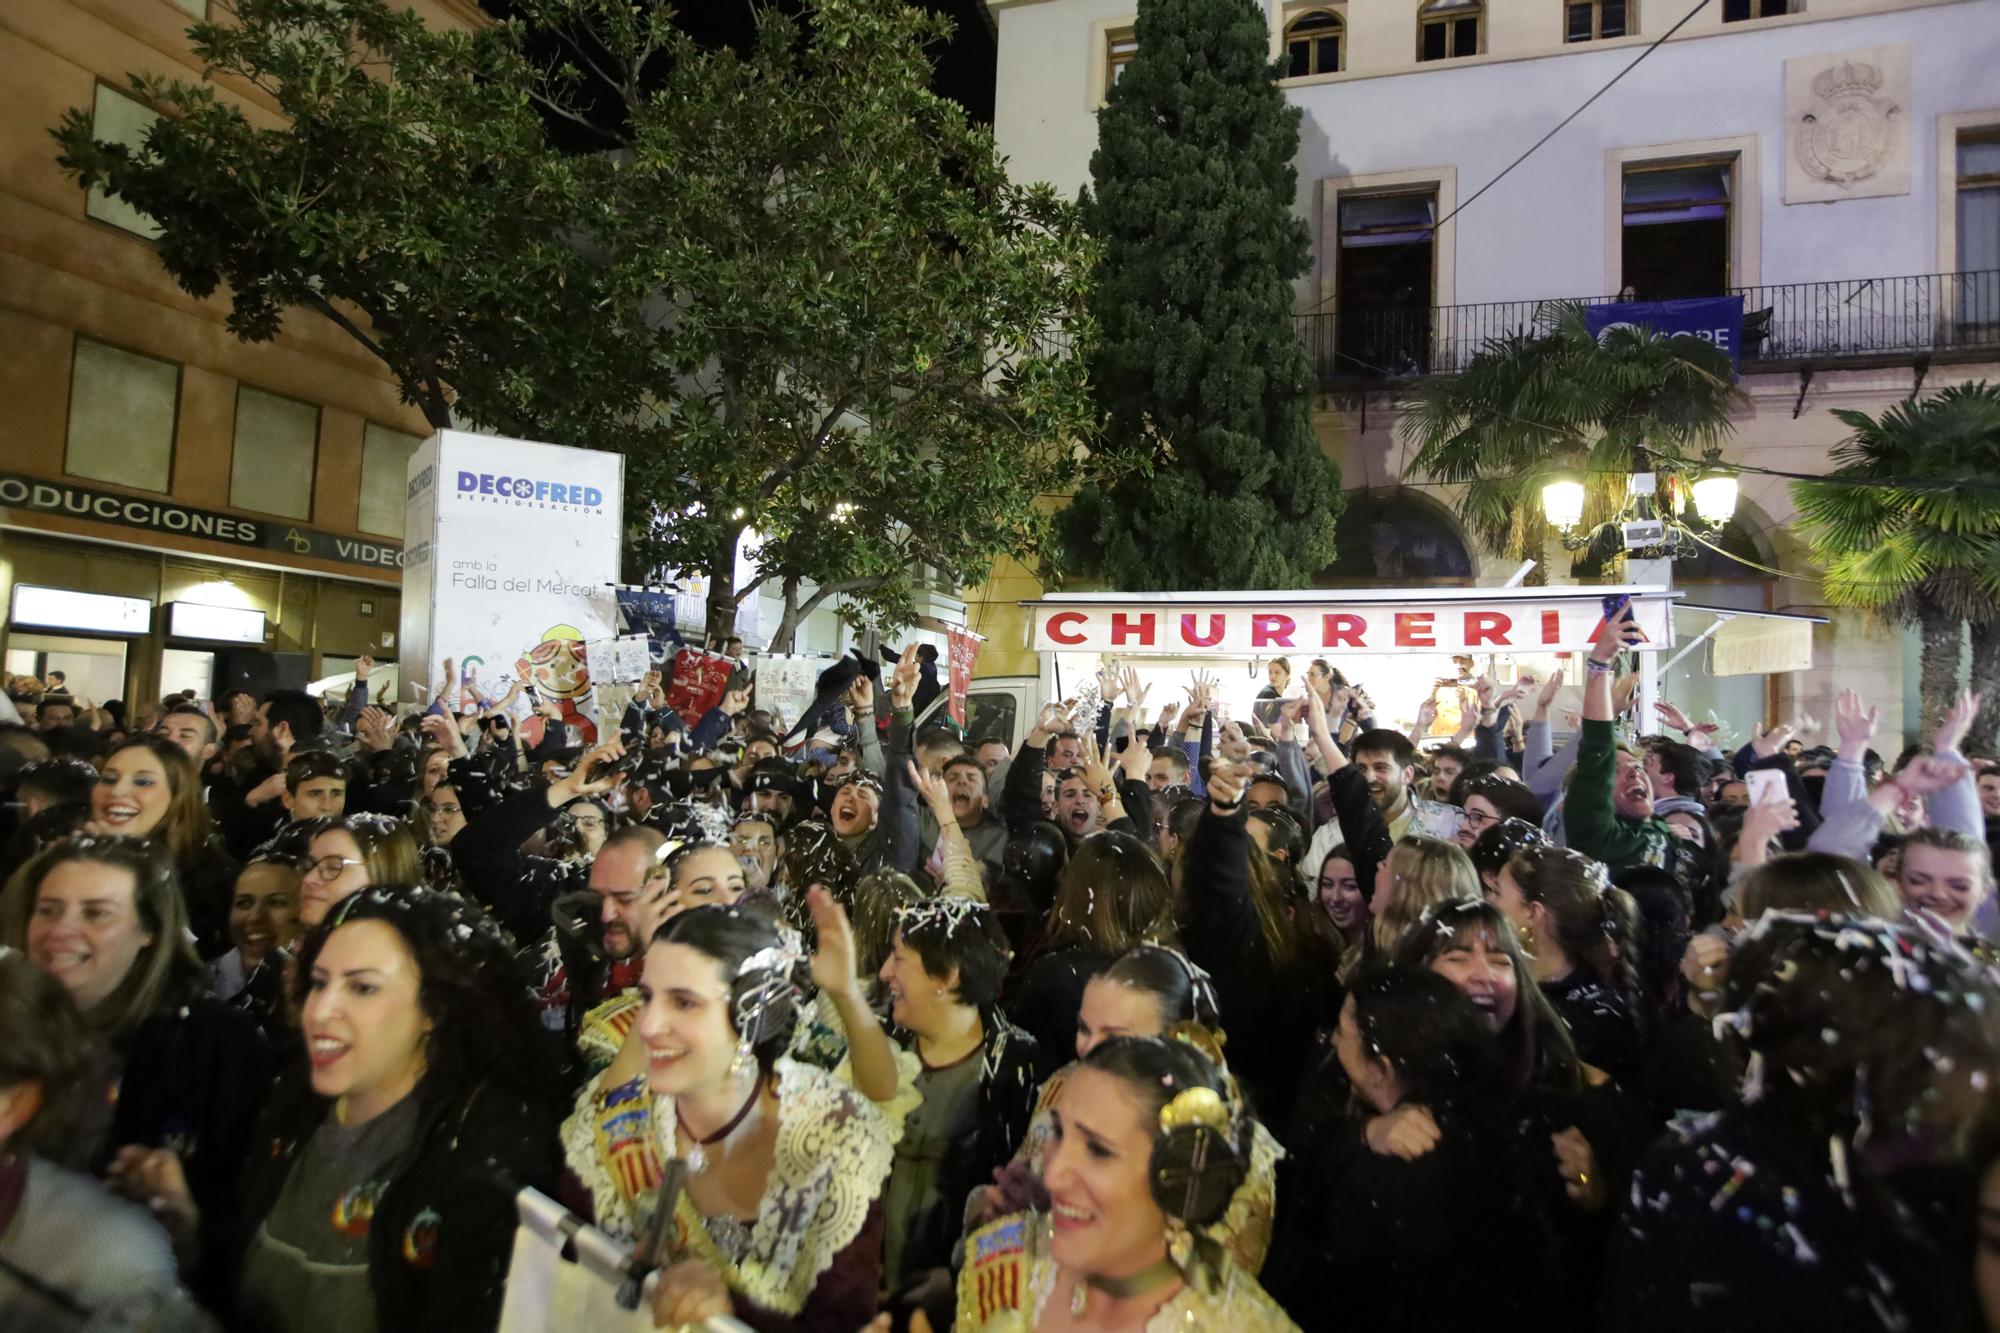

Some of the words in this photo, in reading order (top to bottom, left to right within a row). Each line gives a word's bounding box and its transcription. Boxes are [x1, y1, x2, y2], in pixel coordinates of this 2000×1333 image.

[457, 470, 603, 507] DECOFRED
[452, 560, 483, 570] amb
[486, 561, 498, 572] la
[452, 572, 498, 590] Falla
[503, 577, 532, 593] del
[537, 578, 599, 598] Mercat
[1045, 611, 1651, 648] CHURRERI
